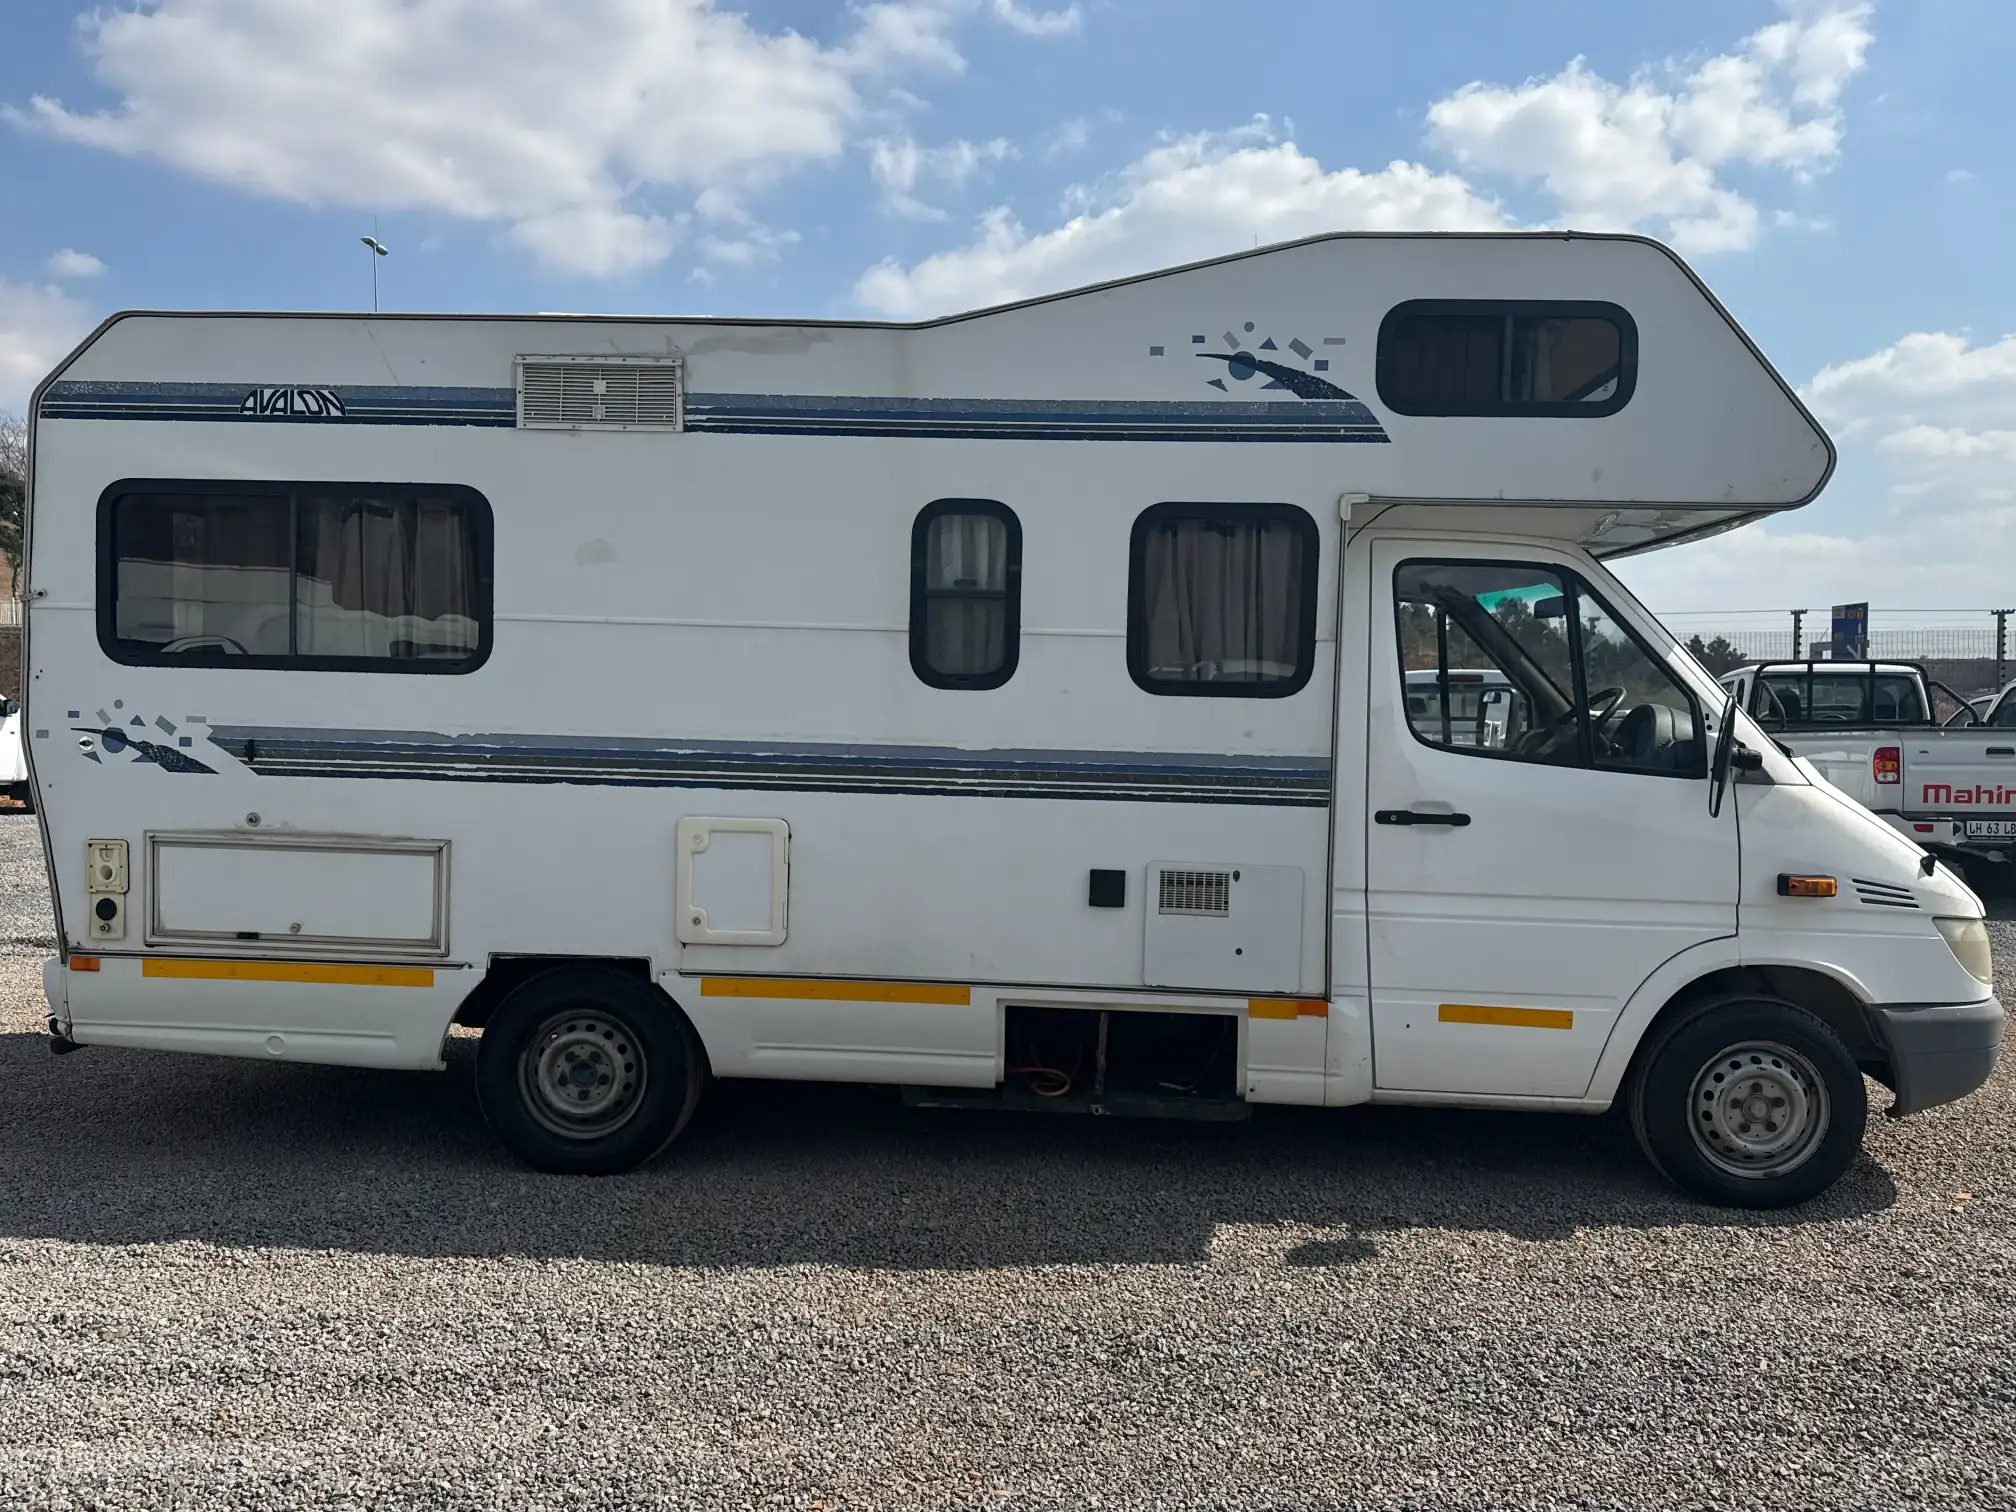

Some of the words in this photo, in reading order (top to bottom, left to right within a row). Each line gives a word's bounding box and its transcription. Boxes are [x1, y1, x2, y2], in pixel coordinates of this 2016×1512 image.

[240, 388, 347, 416] AVALON
[1969, 822, 1982, 834] LH
[1986, 822, 2000, 834] 63
